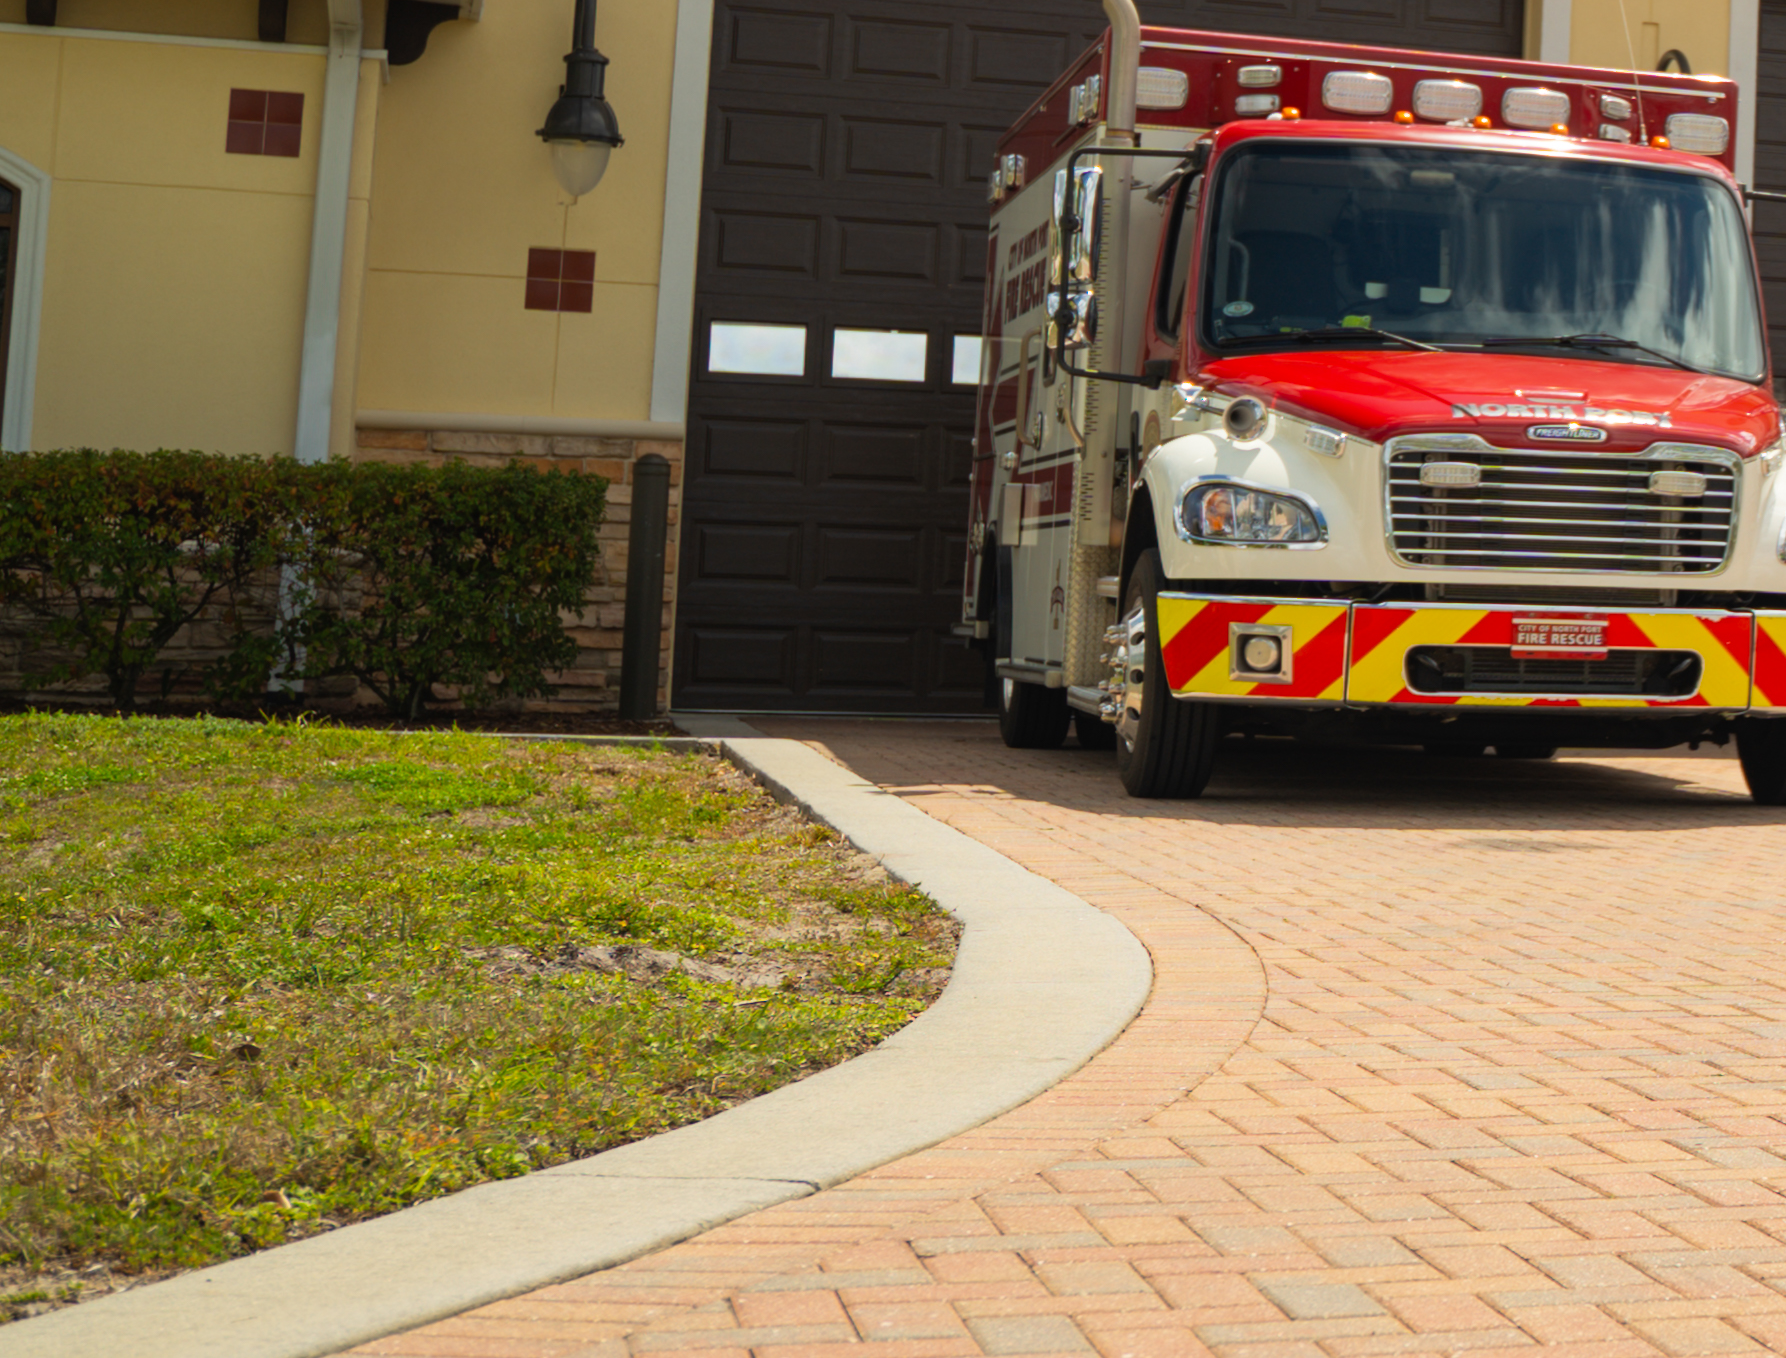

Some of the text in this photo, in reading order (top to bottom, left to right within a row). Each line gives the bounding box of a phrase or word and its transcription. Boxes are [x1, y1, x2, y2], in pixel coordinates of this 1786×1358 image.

[1452, 403, 1673, 428] NORTH PORT
[1535, 427, 1600, 440] FREIGHTLINER
[1517, 624, 1537, 632] CITY
[1551, 625, 1579, 633] NORTH
[1517, 632, 1603, 645] FIRE RESCUE
